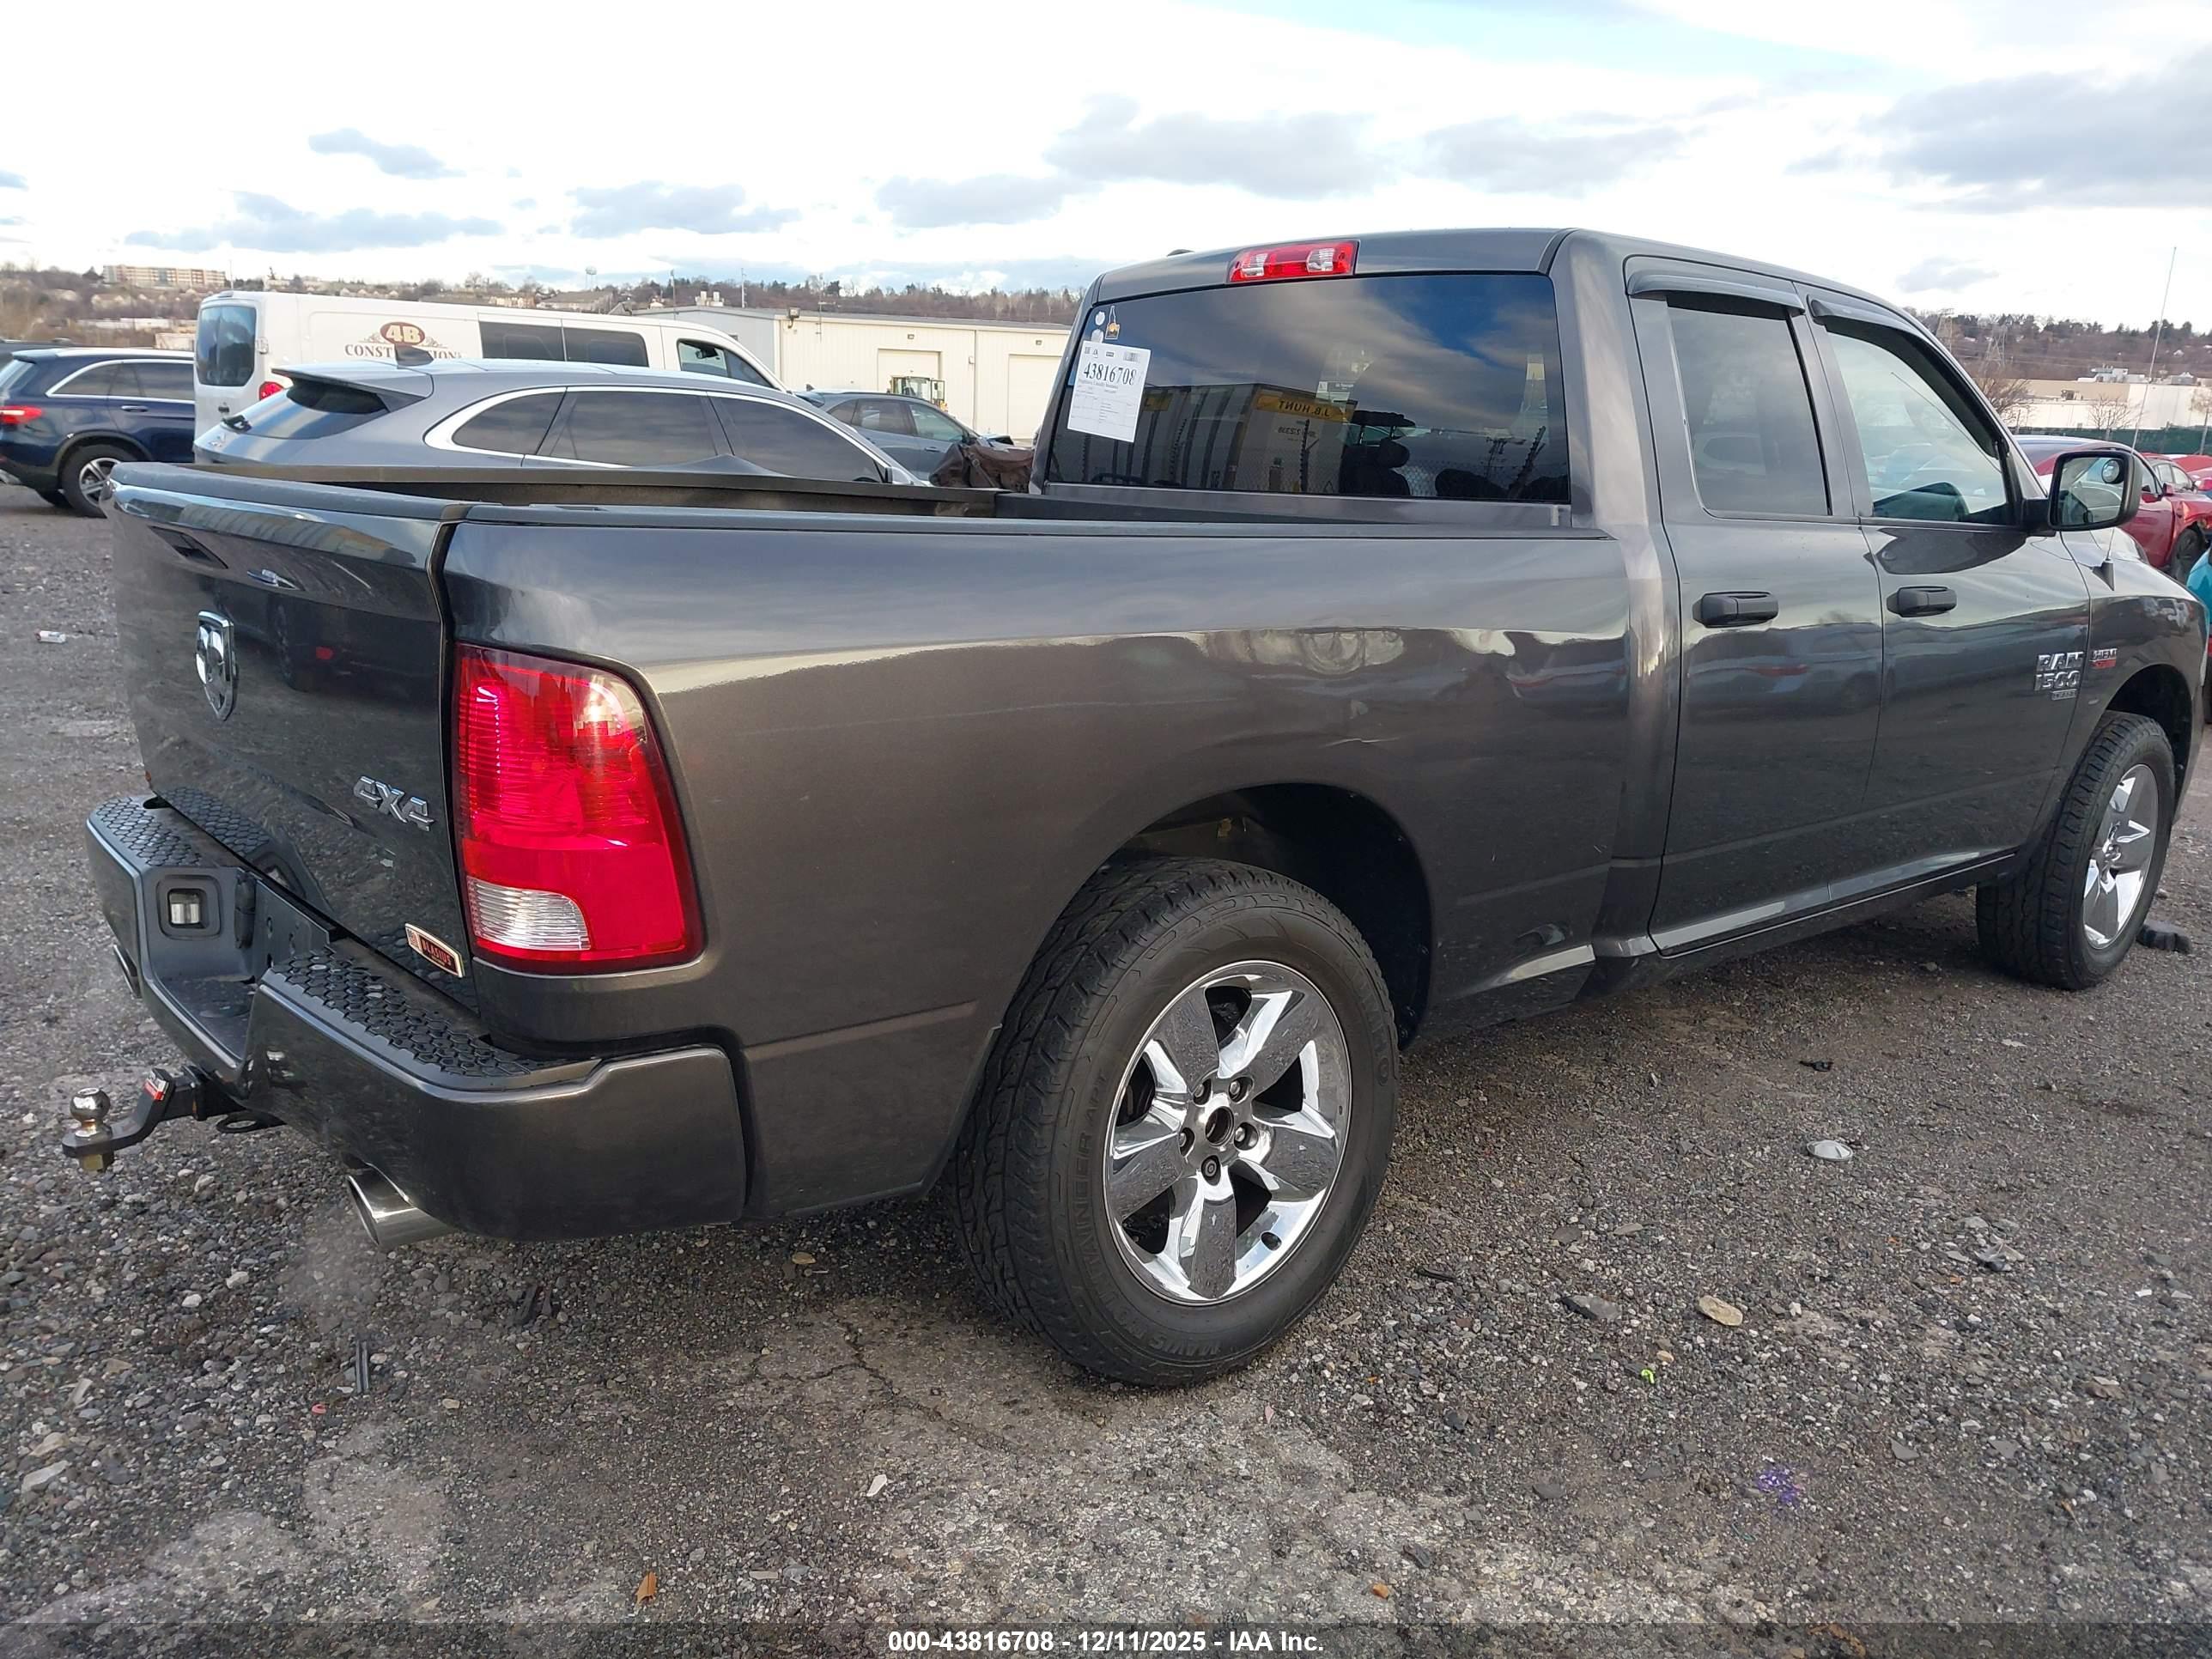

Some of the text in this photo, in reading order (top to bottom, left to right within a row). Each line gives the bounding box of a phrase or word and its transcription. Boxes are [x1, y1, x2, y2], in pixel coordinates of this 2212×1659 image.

[386, 325, 422, 343] 4B
[1084, 362, 1137, 386] 43816708
[2037, 651, 2084, 671] RAM
[2034, 670, 2081, 691] 1500
